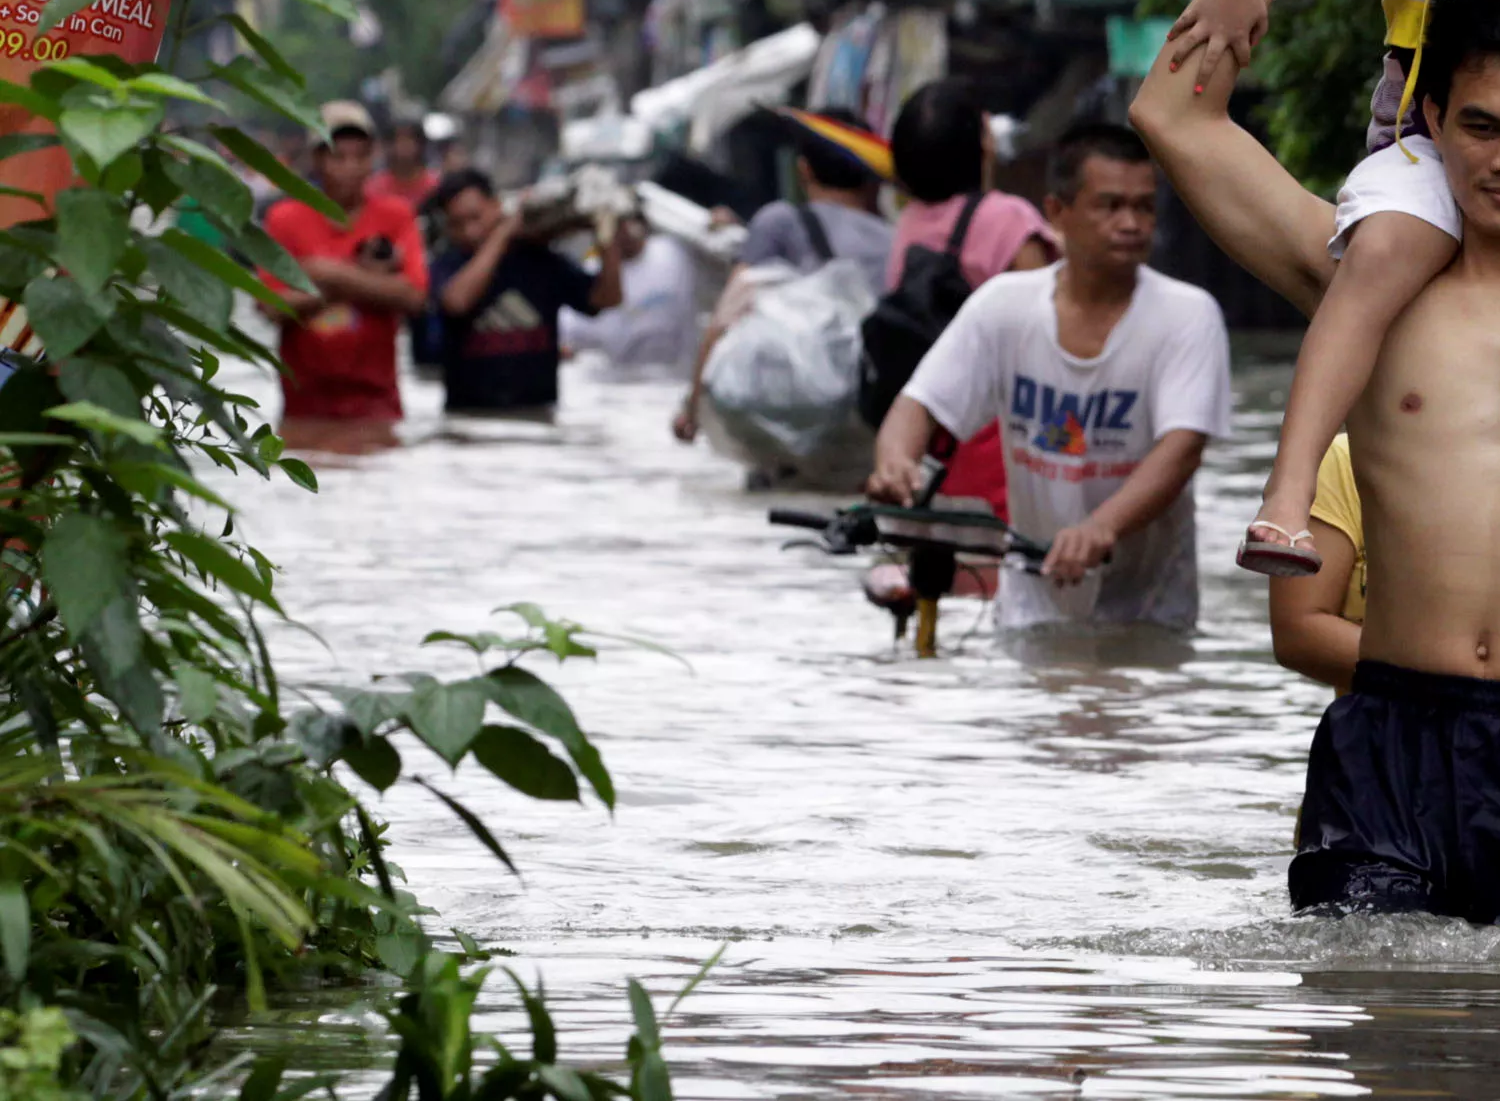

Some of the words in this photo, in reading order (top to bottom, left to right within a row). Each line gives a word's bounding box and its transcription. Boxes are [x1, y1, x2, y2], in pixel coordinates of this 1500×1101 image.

[16, 4, 64, 28] So
[70, 14, 86, 31] in
[91, 18, 122, 41] Can
